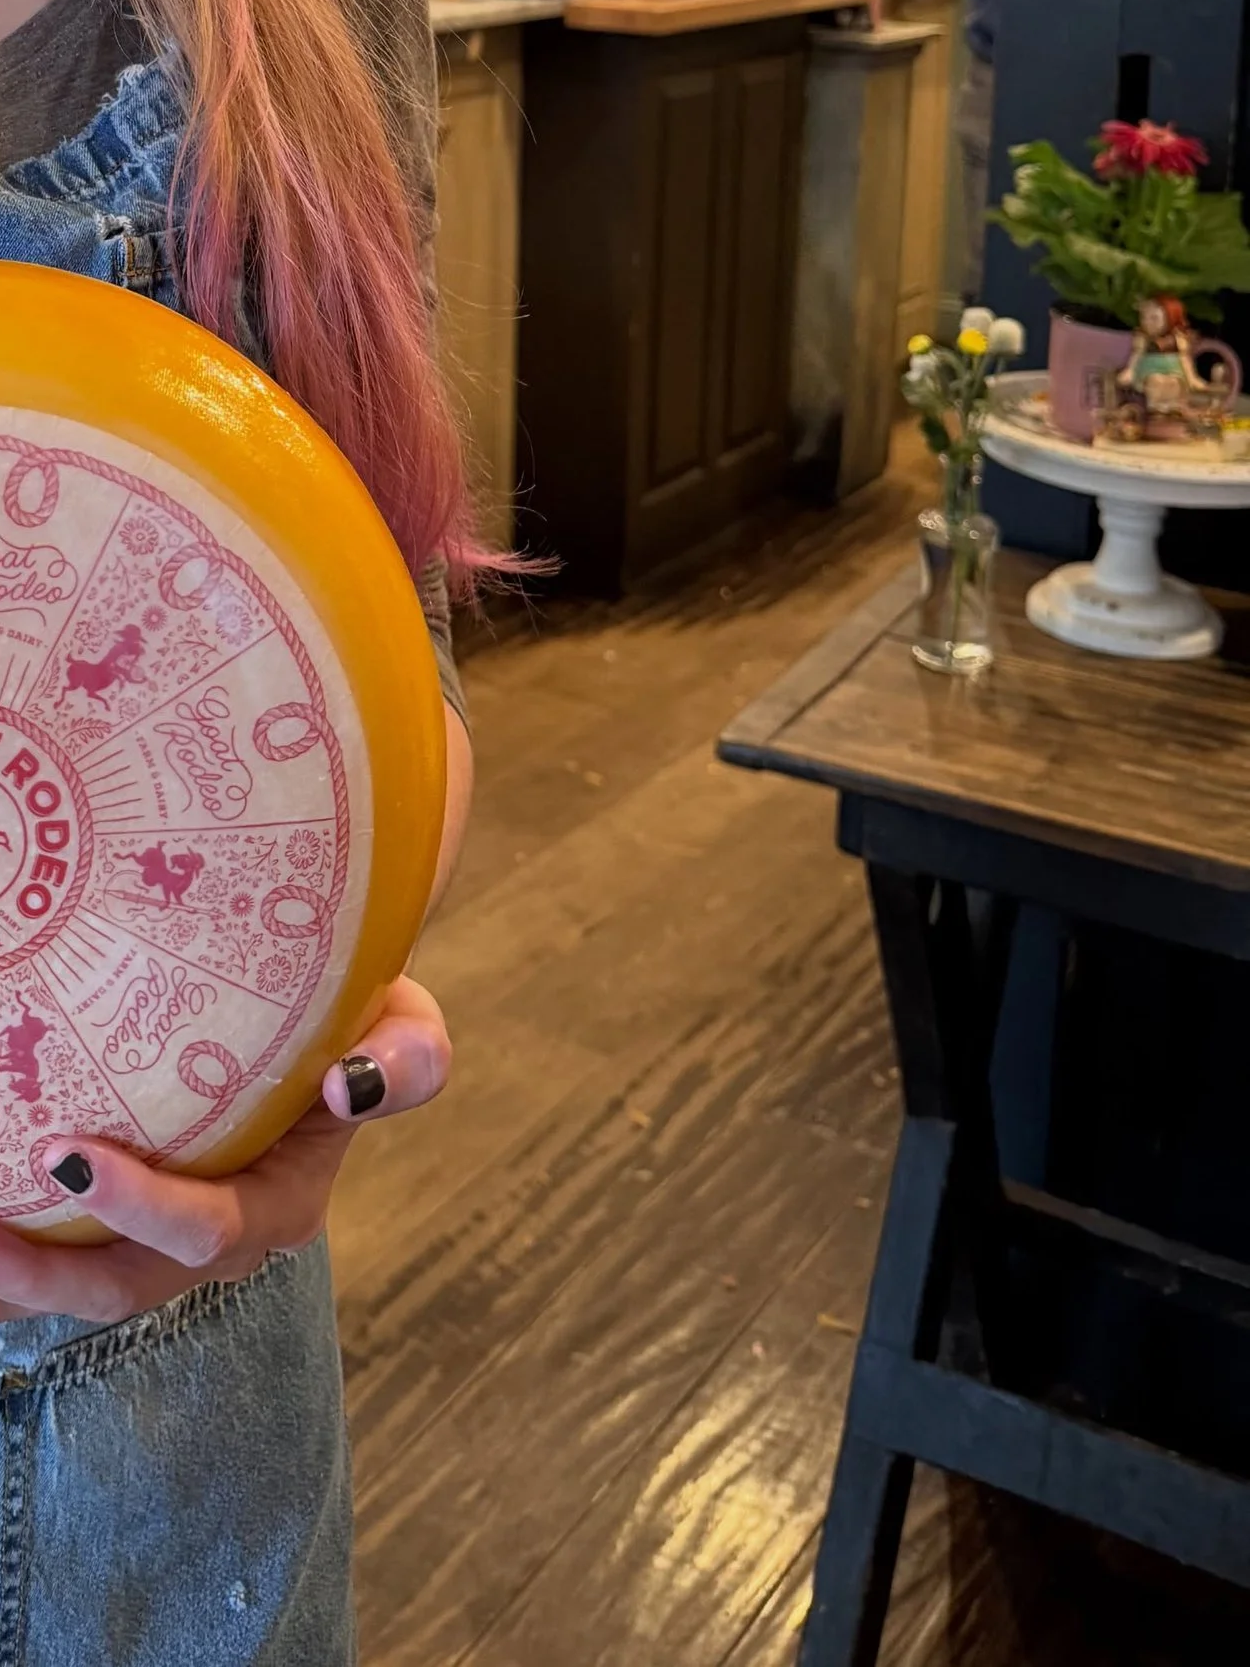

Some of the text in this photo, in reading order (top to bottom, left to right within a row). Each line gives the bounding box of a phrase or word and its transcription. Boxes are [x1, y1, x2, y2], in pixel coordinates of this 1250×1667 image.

[6, 628, 44, 649] DAIRY
[152, 722, 224, 812] Rodeo
[175, 685, 242, 772] Goat
[1, 748, 70, 919] RODEO
[104, 957, 168, 1054] Rodeo
[147, 966, 217, 1048] Goat
